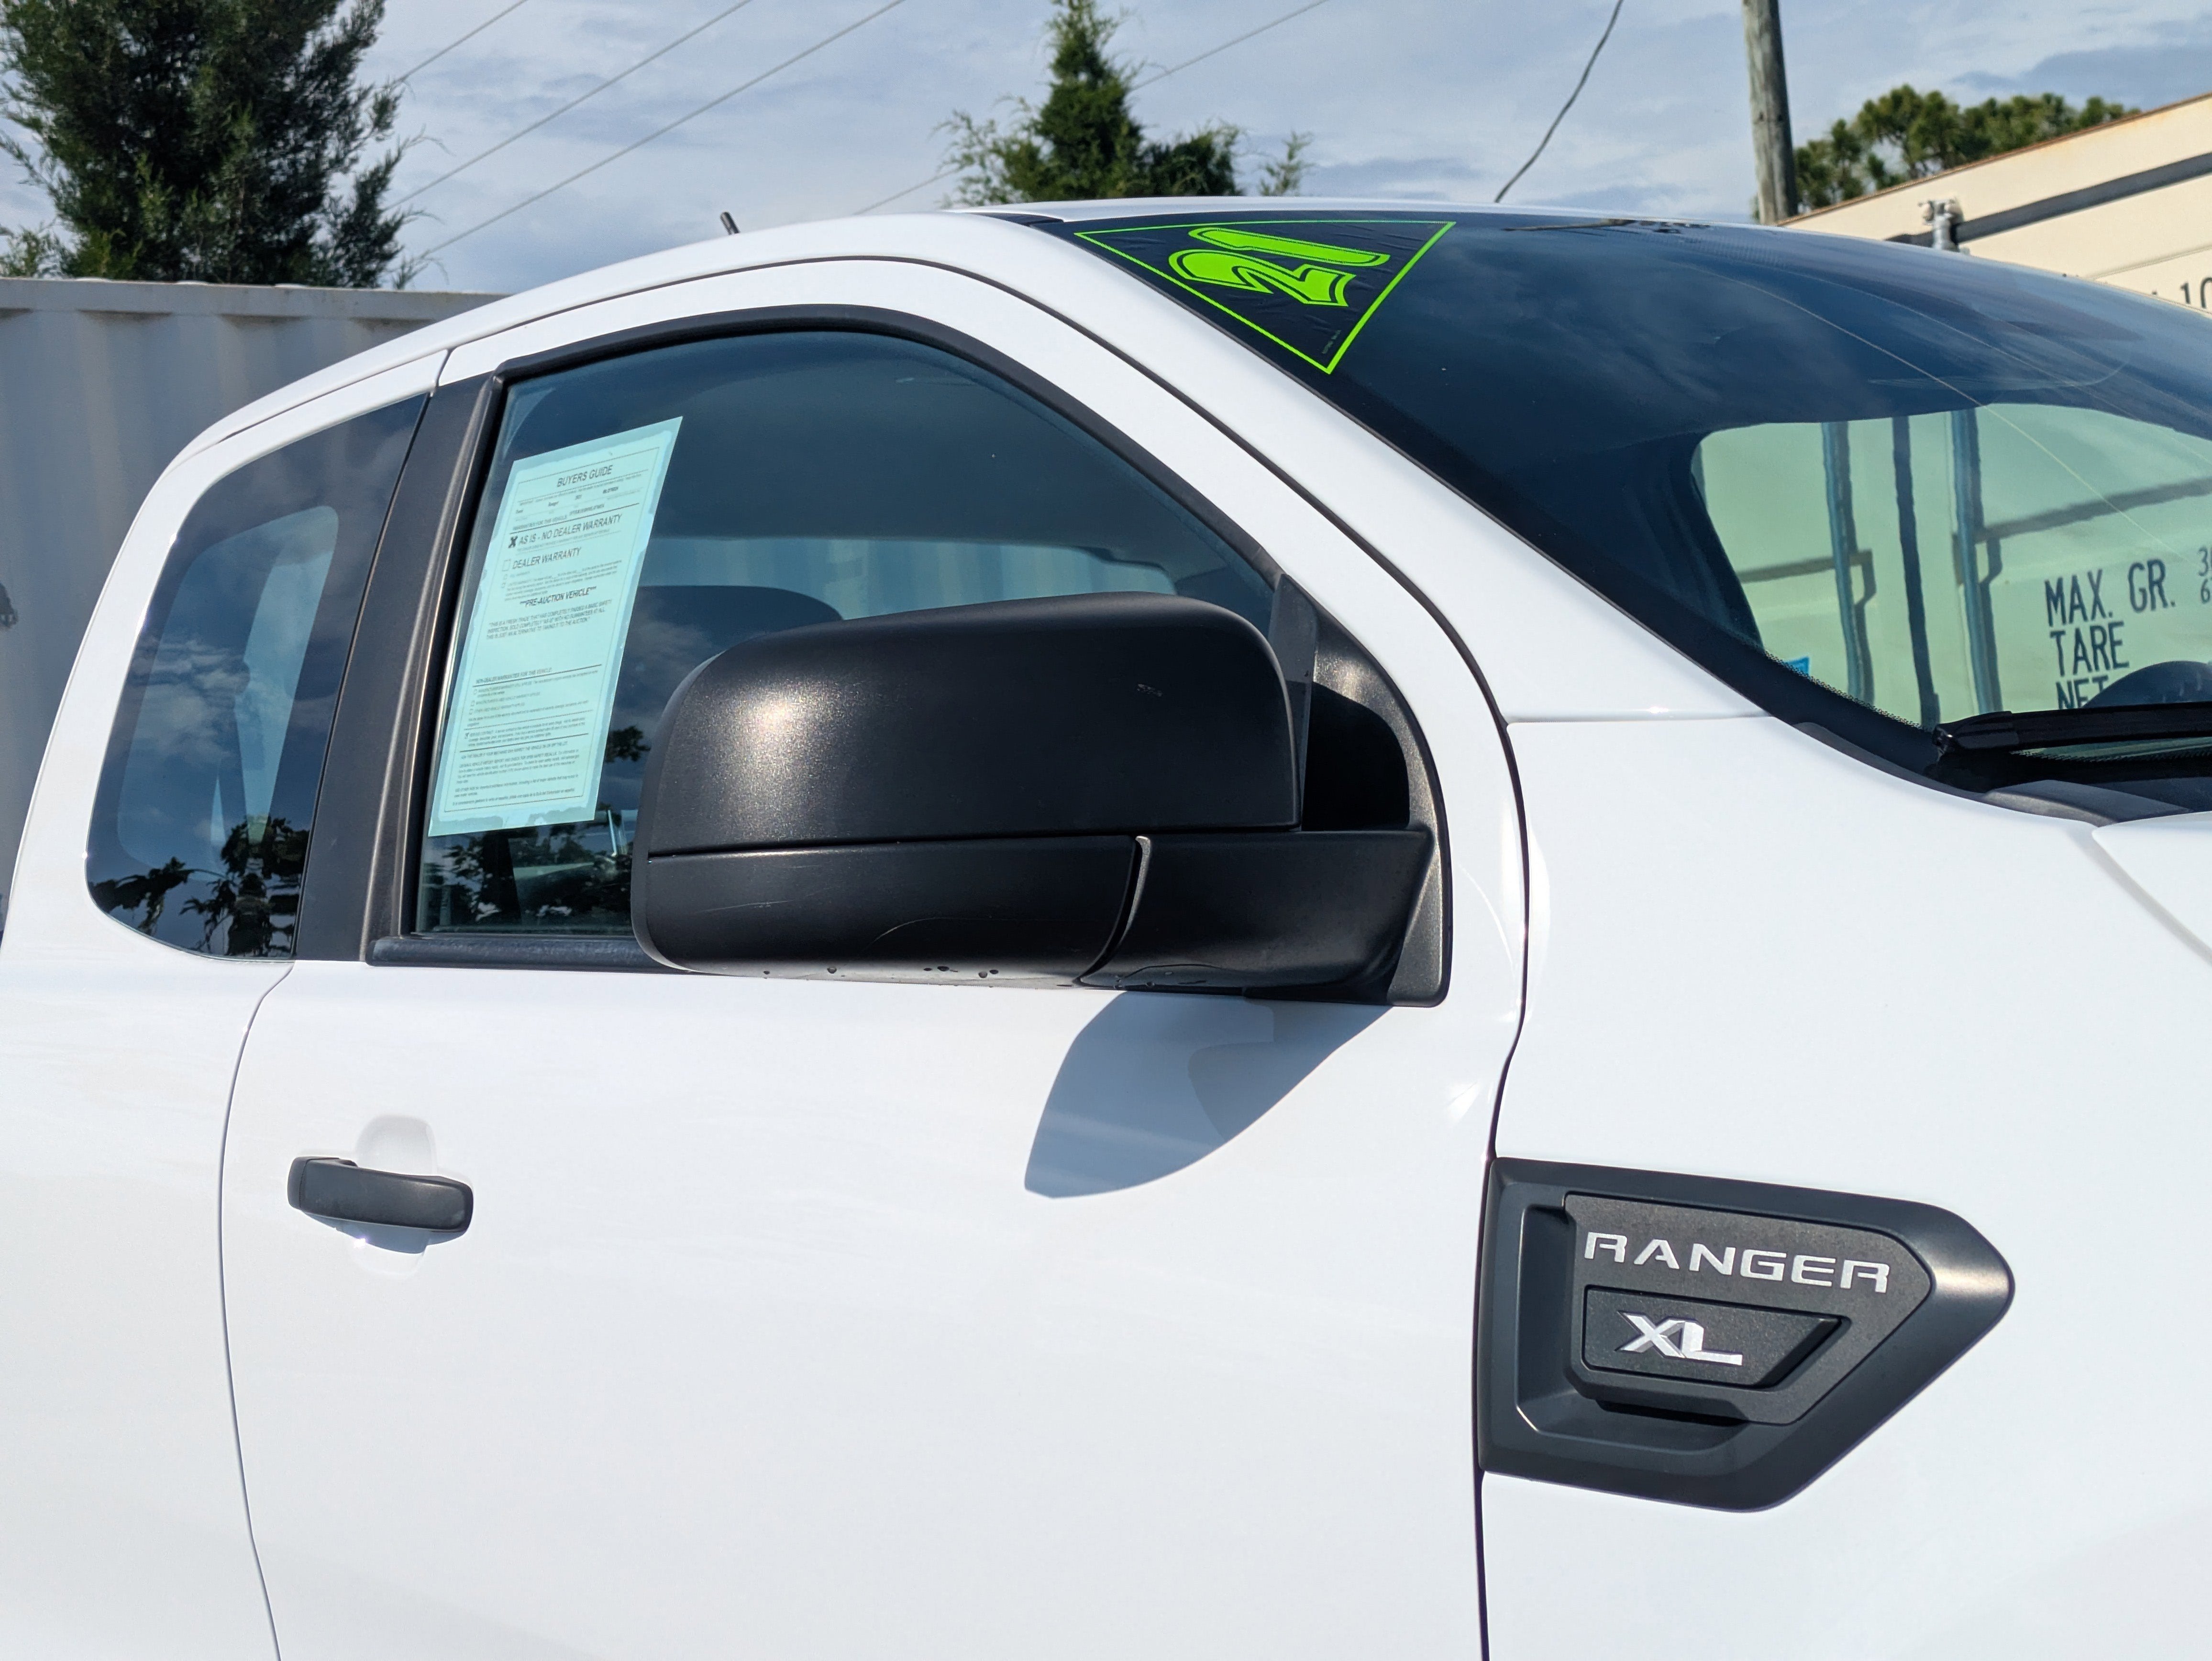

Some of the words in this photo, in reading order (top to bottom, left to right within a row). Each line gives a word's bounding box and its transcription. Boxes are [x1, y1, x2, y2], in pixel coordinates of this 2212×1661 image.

[1169, 227, 1391, 307] 21
[557, 471, 587, 487] BUYERS
[589, 465, 612, 479] GUIDE
[519, 535, 528, 545] AS
[529, 533, 537, 543] IS
[542, 530, 552, 540] NO
[553, 523, 581, 537] DEALER
[583, 513, 621, 530] WARRANTY
[512, 555, 541, 570] DEALER
[542, 547, 581, 563] WARRANTY
[2045, 569, 2113, 627] MAX.
[2128, 559, 2176, 613] GR.
[2050, 621, 2130, 677] TARE
[1584, 1232, 1890, 1293] RANGER
[1615, 1310, 1743, 1366] XL
